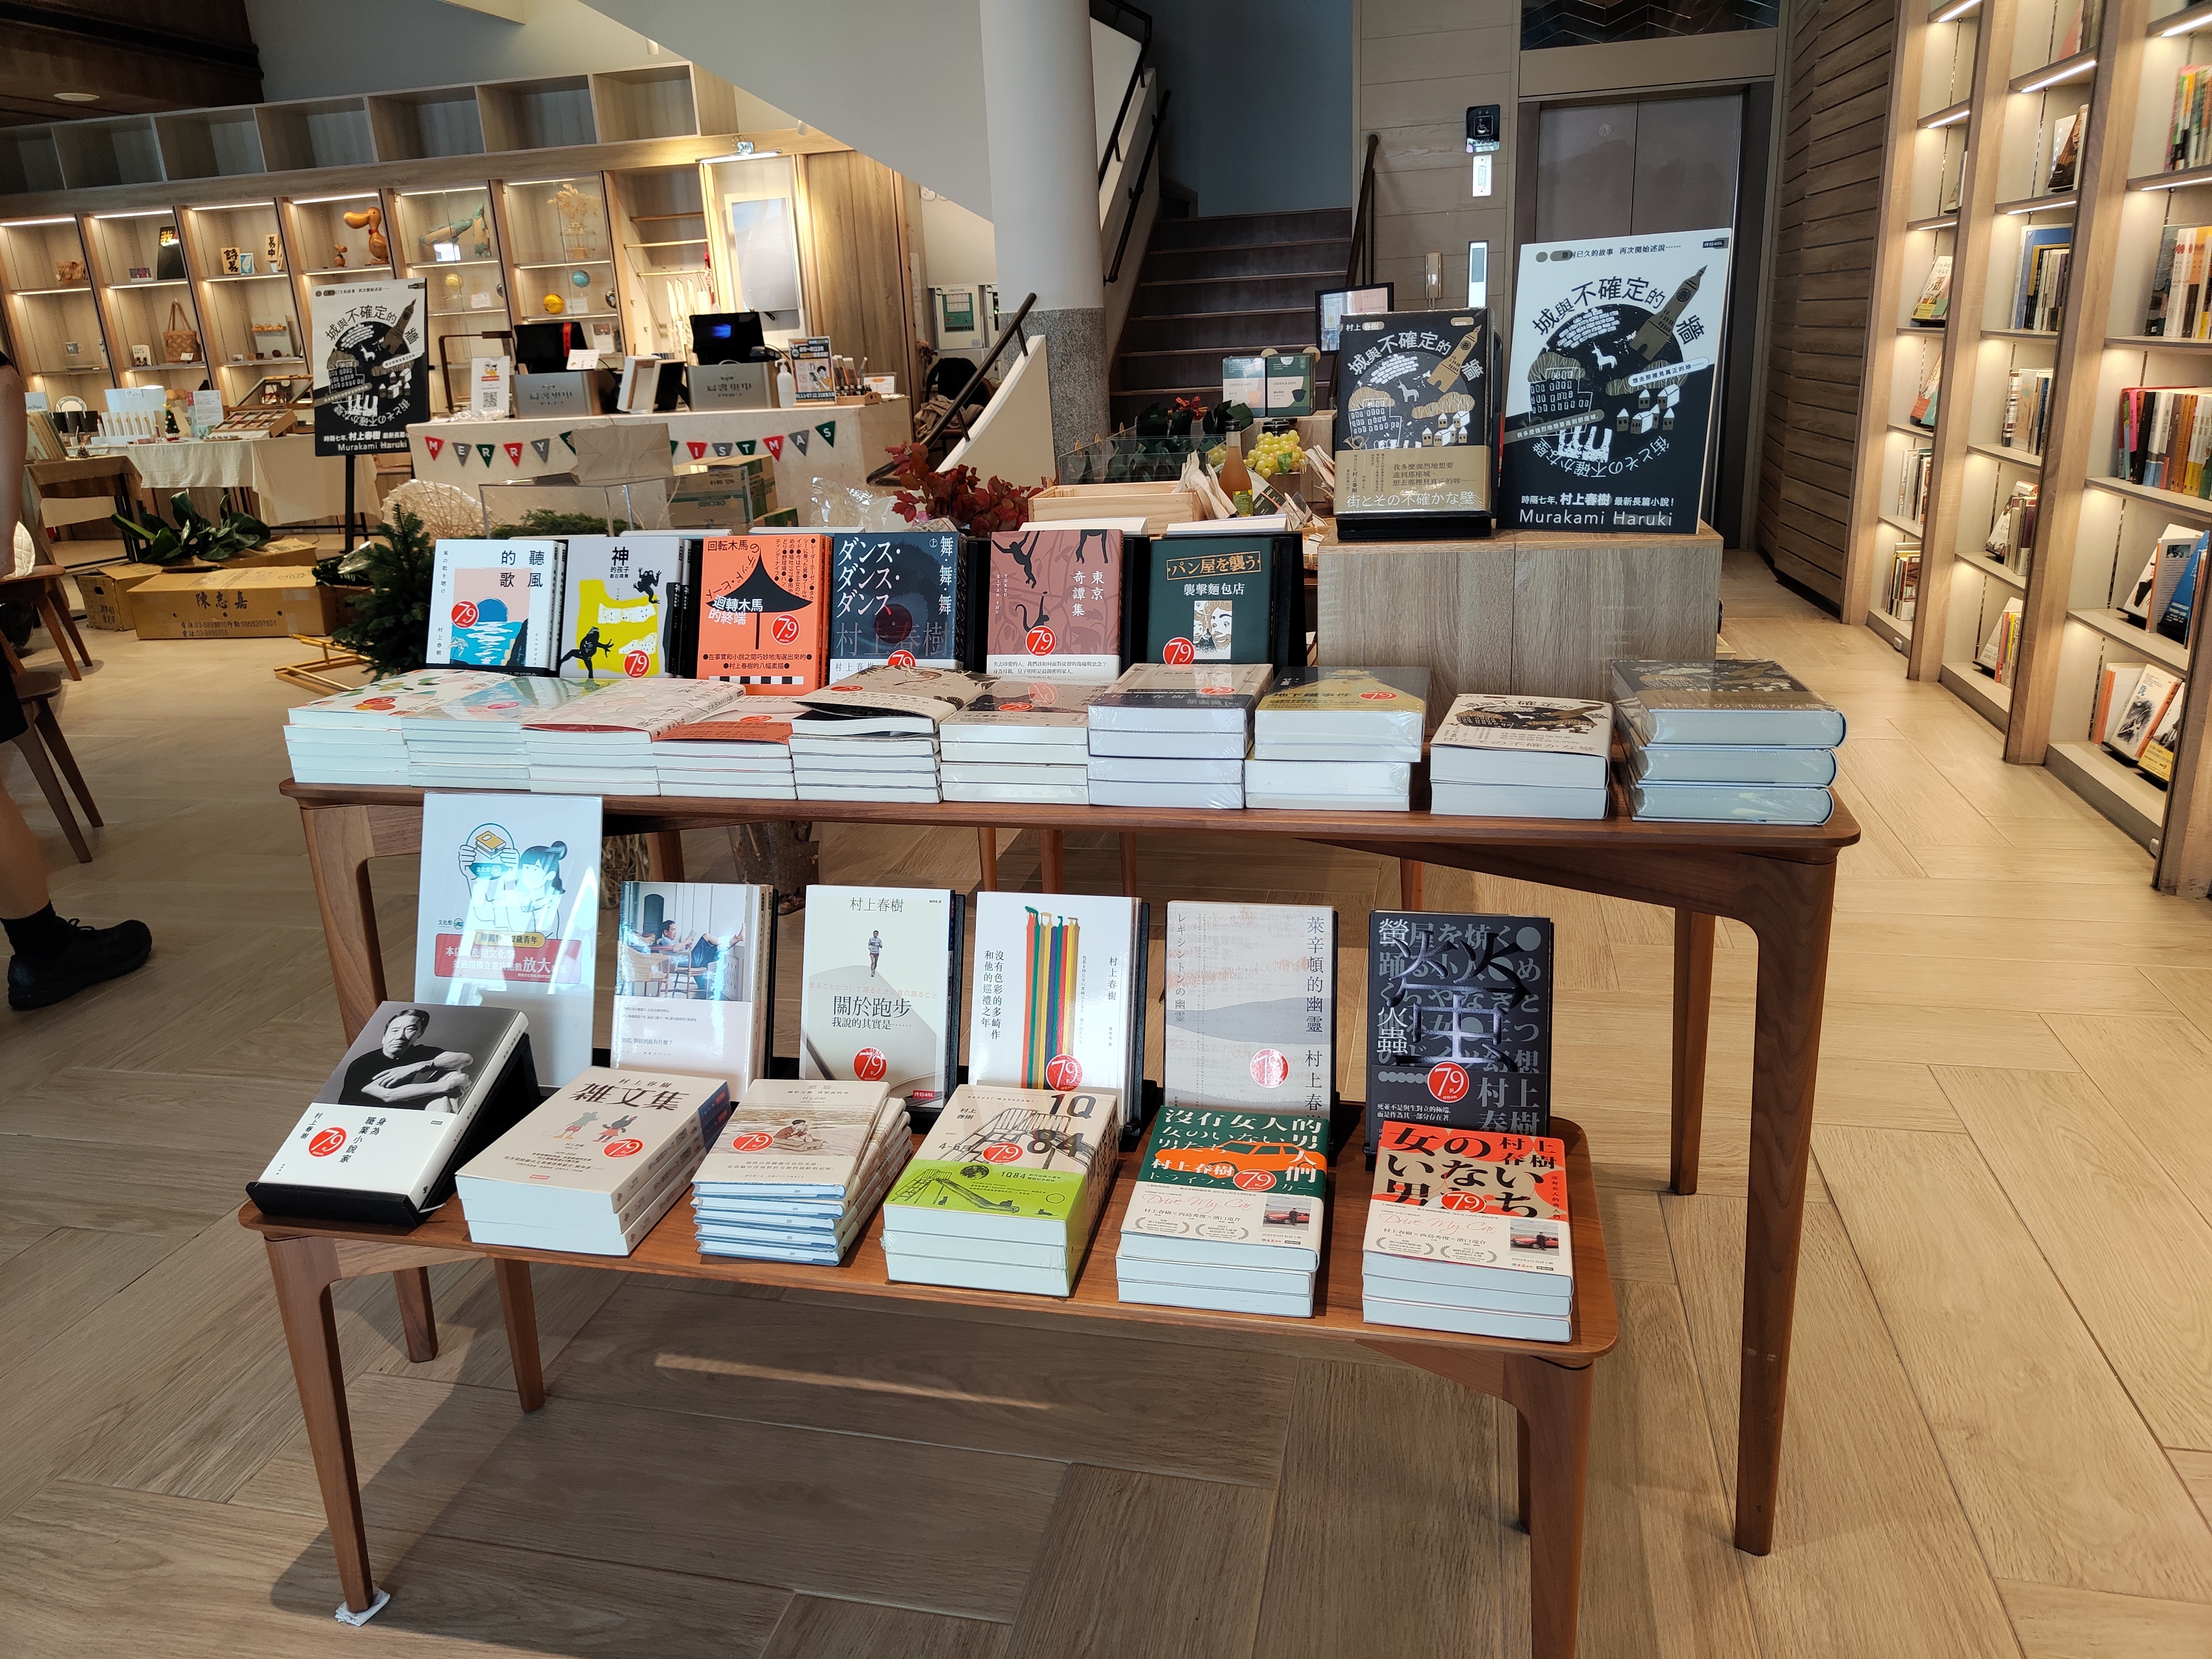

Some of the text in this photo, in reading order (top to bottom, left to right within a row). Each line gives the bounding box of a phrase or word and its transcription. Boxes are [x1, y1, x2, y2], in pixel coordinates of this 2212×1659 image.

[1532, 276, 1705, 345] 城與不確定的 牆
[325, 305, 397, 341] 城與不確定的
[1346, 322, 1379, 332] 村上春樹
[1348, 331, 1485, 381] 城與不確定的 牆
[338, 440, 407, 451] Murakami Haruki
[348, 431, 381, 441] 村上春樹
[429, 441, 544, 457] MERRY
[1393, 462, 1453, 471] 我多麼強烈地想要
[1346, 491, 1474, 508] 街とその不確かな壁
[1560, 493, 1611, 506] 村上春樹
[1520, 509, 1673, 527] Murakami Haruki
[611, 547, 629, 566] 神
[1170, 554, 1260, 576] パン屋を襲う
[196, 591, 248, 609] 陳志嘉
[1072, 571, 1104, 616] 東京 奇譚集
[1183, 583, 1245, 596] 襲擊麵包店
[453, 603, 477, 624] 79
[712, 594, 763, 612] 迴轉木馬
[836, 592, 892, 619] ダンス
[708, 608, 747, 625] 的終端
[777, 618, 797, 639] 79
[1031, 630, 1053, 652] 79
[628, 653, 648, 675] 79
[1168, 642, 1192, 665] 79
[849, 896, 903, 913] 村上春樹
[523, 956, 551, 973] 放大
[1174, 913, 1186, 1022] レキシントンの幽霊
[1107, 956, 1118, 1001] 村上春樹
[981, 950, 1004, 1040] 沒有色彩的多崎作 和他的巡禮之年
[833, 995, 912, 1018] 關於跑步
[1304, 916, 1325, 1117] 萊辛頓的幽靈 村上春
[859, 1052, 884, 1078] 79
[1051, 1060, 1078, 1088] 79
[619, 1078, 672, 1088] 村上春樹
[1434, 1068, 1464, 1097] 79
[1477, 1077, 1540, 1108] 村上
[569, 1082, 690, 1111] 雜文集
[1050, 1094, 1096, 1119] 1Q
[300, 1112, 323, 1139] 村上春樹
[1477, 1110, 1540, 1136] 春樹
[311, 1129, 344, 1152] 79
[339, 1116, 387, 1163] 身為 職業小說家
[738, 1134, 770, 1149] 79
[1027, 1130, 1084, 1157] 84
[1162, 1126, 1285, 1143] 女のいない
[1387, 1127, 1491, 1158] 女の
[1499, 1136, 1556, 1154] 村上
[605, 1140, 639, 1156] 79
[989, 1145, 1021, 1160] 79
[1158, 1138, 1226, 1154] 男たち
[1165, 1109, 1321, 1183] 沒有女人的 男人們
[1151, 1158, 1235, 1178] 村上春樹
[1388, 1154, 1544, 1188] いない
[1500, 1152, 1555, 1169] 春樹
[1001, 1171, 1026, 1179] 1Q84
[1240, 1172, 1272, 1188] 79
[1142, 1194, 1255, 1213] Drive My Car
[1446, 1193, 1480, 1210] 79
[1551, 1175, 1561, 1220] 沒有女人的男人們
[1379, 1213, 1424, 1225] Drive
[1427, 1218, 1465, 1236] My
[1467, 1222, 1498, 1234] Car
